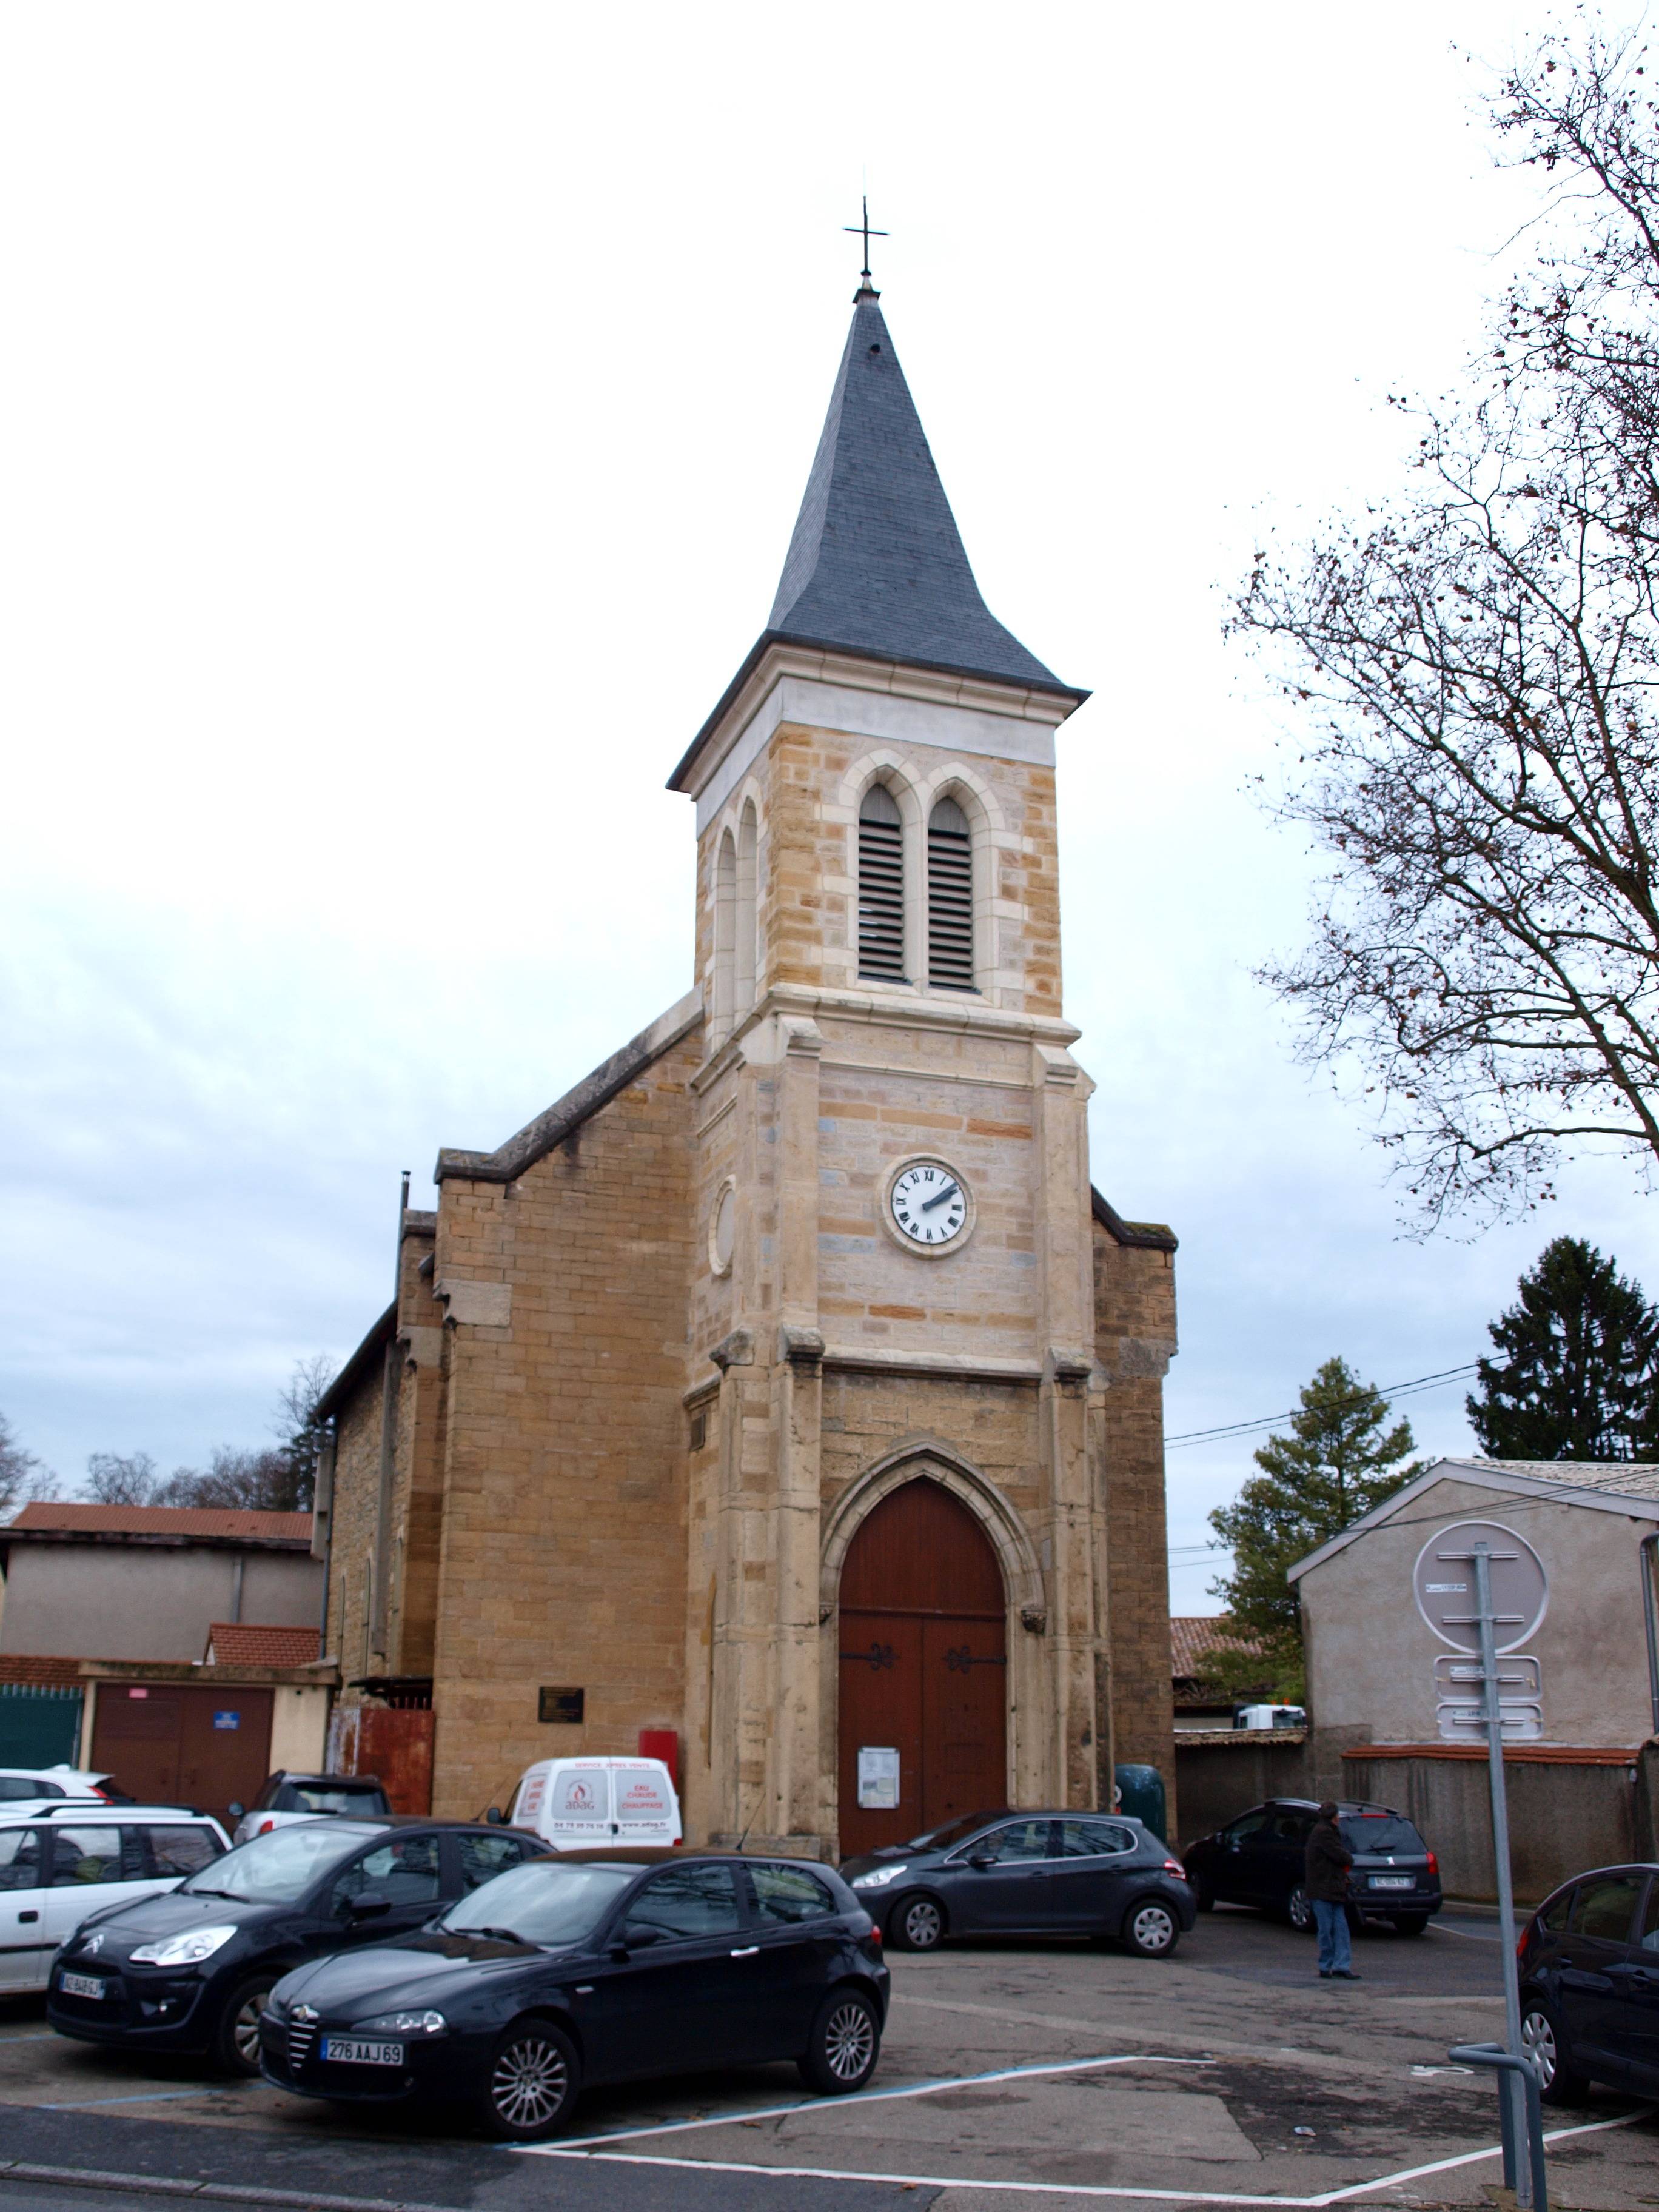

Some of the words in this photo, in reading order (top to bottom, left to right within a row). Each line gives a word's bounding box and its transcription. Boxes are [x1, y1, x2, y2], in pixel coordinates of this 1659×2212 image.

[909, 1171, 920, 1185] XI
[924, 1170, 934, 1182] XII
[899, 1182, 910, 1193] X
[896, 1197, 907, 1205] IX
[926, 1228, 934, 1240] VI
[940, 1226, 948, 1238] V
[329, 2042, 352, 2059] 276
[356, 2045, 380, 2061] AAJ
[383, 2046, 400, 2062] 69
